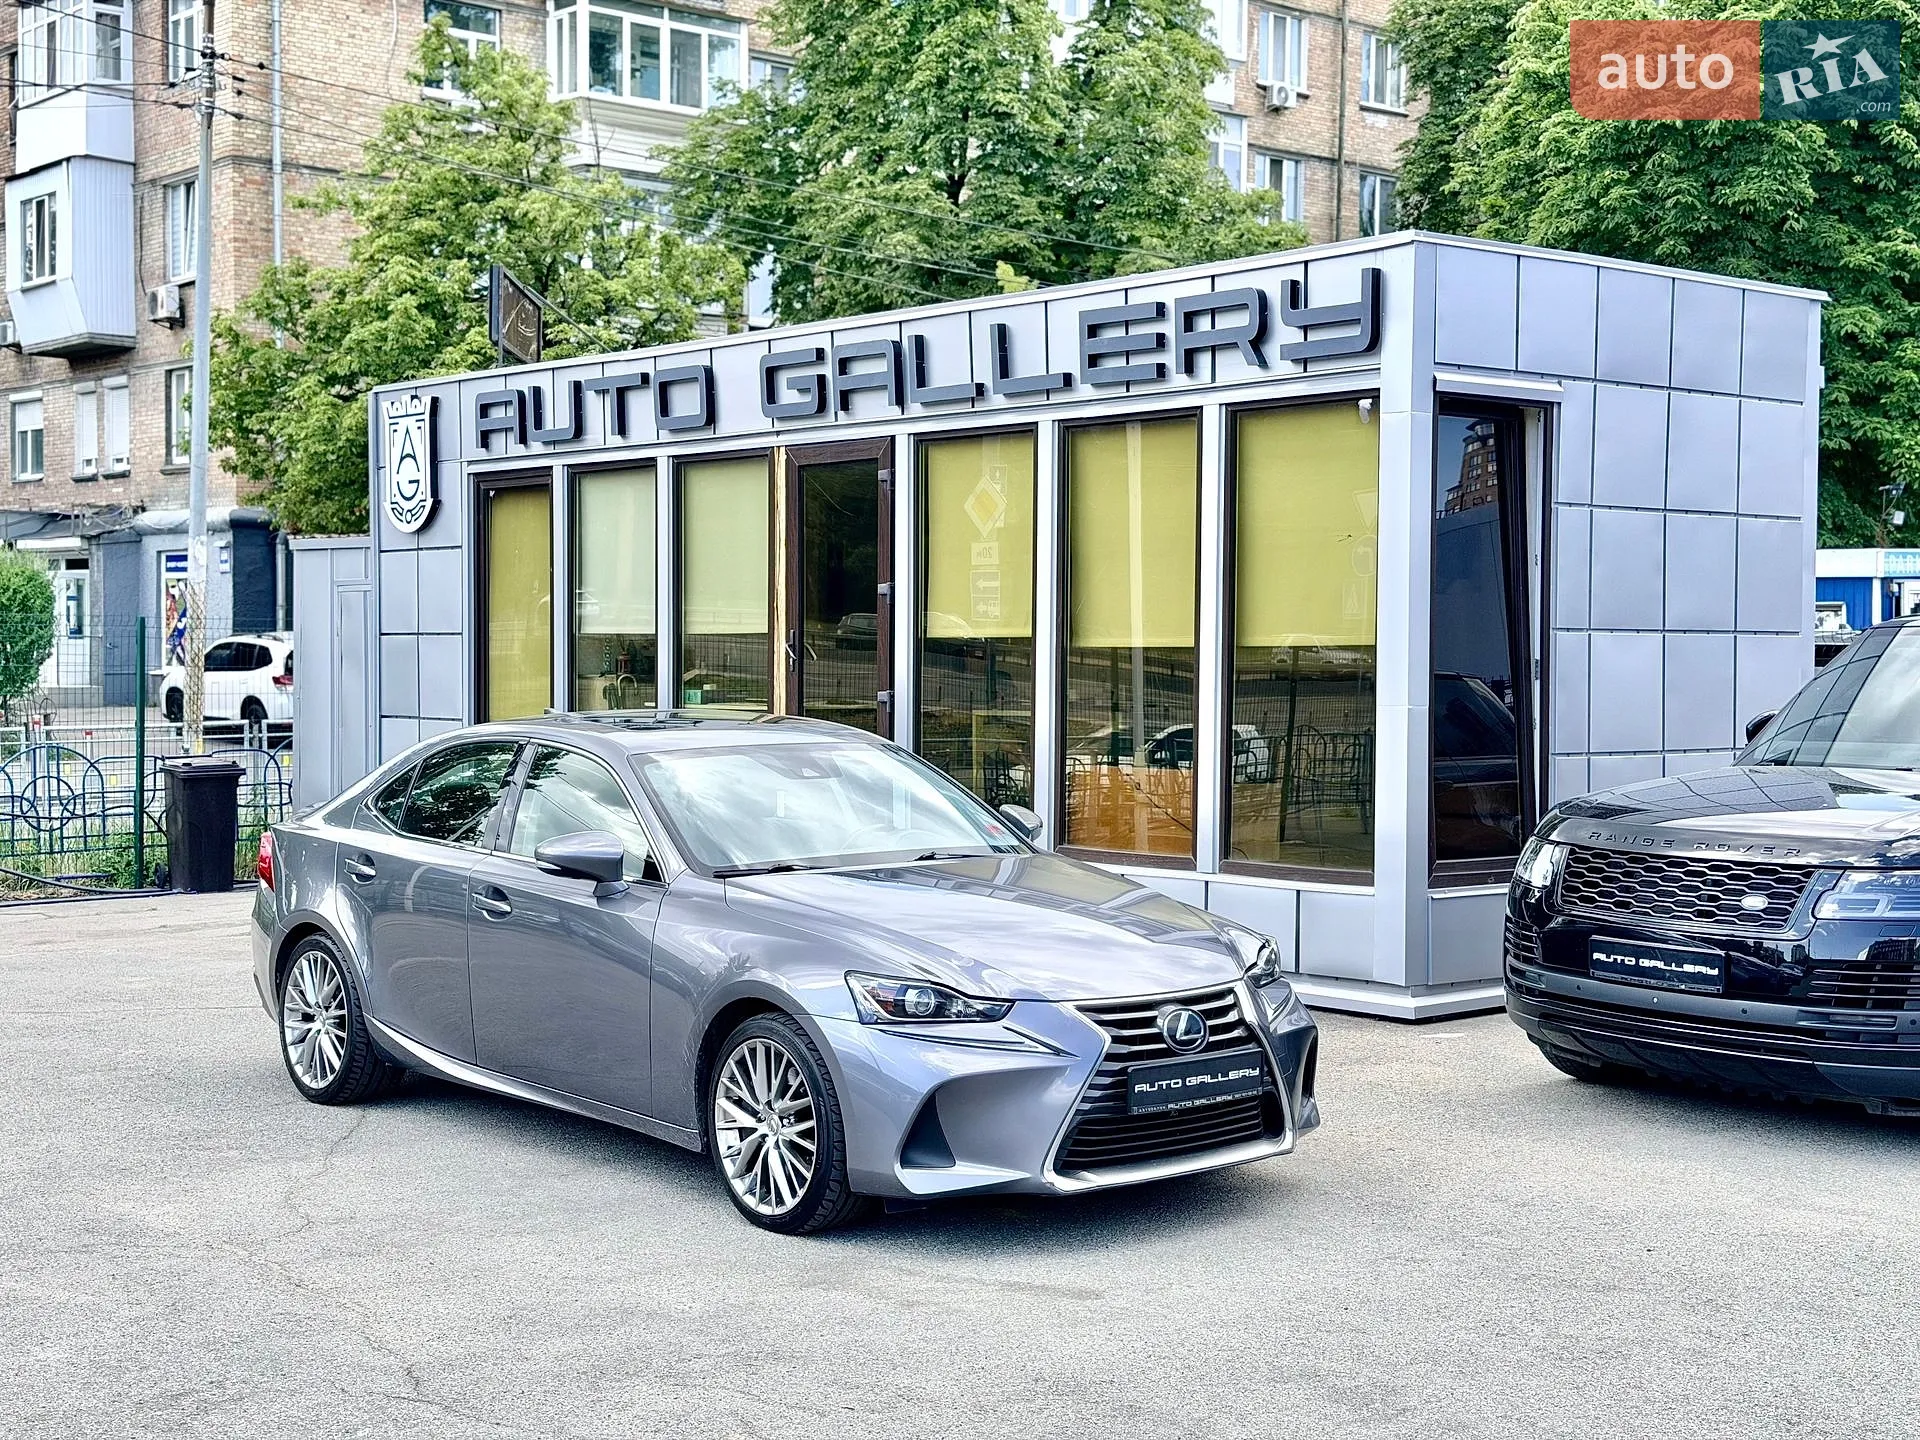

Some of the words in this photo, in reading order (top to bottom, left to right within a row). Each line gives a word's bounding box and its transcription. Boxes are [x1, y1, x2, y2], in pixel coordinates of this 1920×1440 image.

[475, 364, 716, 449] AUTO
[759, 267, 1383, 419] GALLERY
[1587, 831, 1676, 848] RANGE
[1693, 842, 1801, 857] ROVER
[1592, 952, 1636, 966] AUTO
[1638, 958, 1719, 976] GALLERY
[1134, 1079, 1182, 1094] AUTO
[1186, 1067, 1260, 1086] GALLERY
[1167, 1101, 1192, 1110] AUTO
